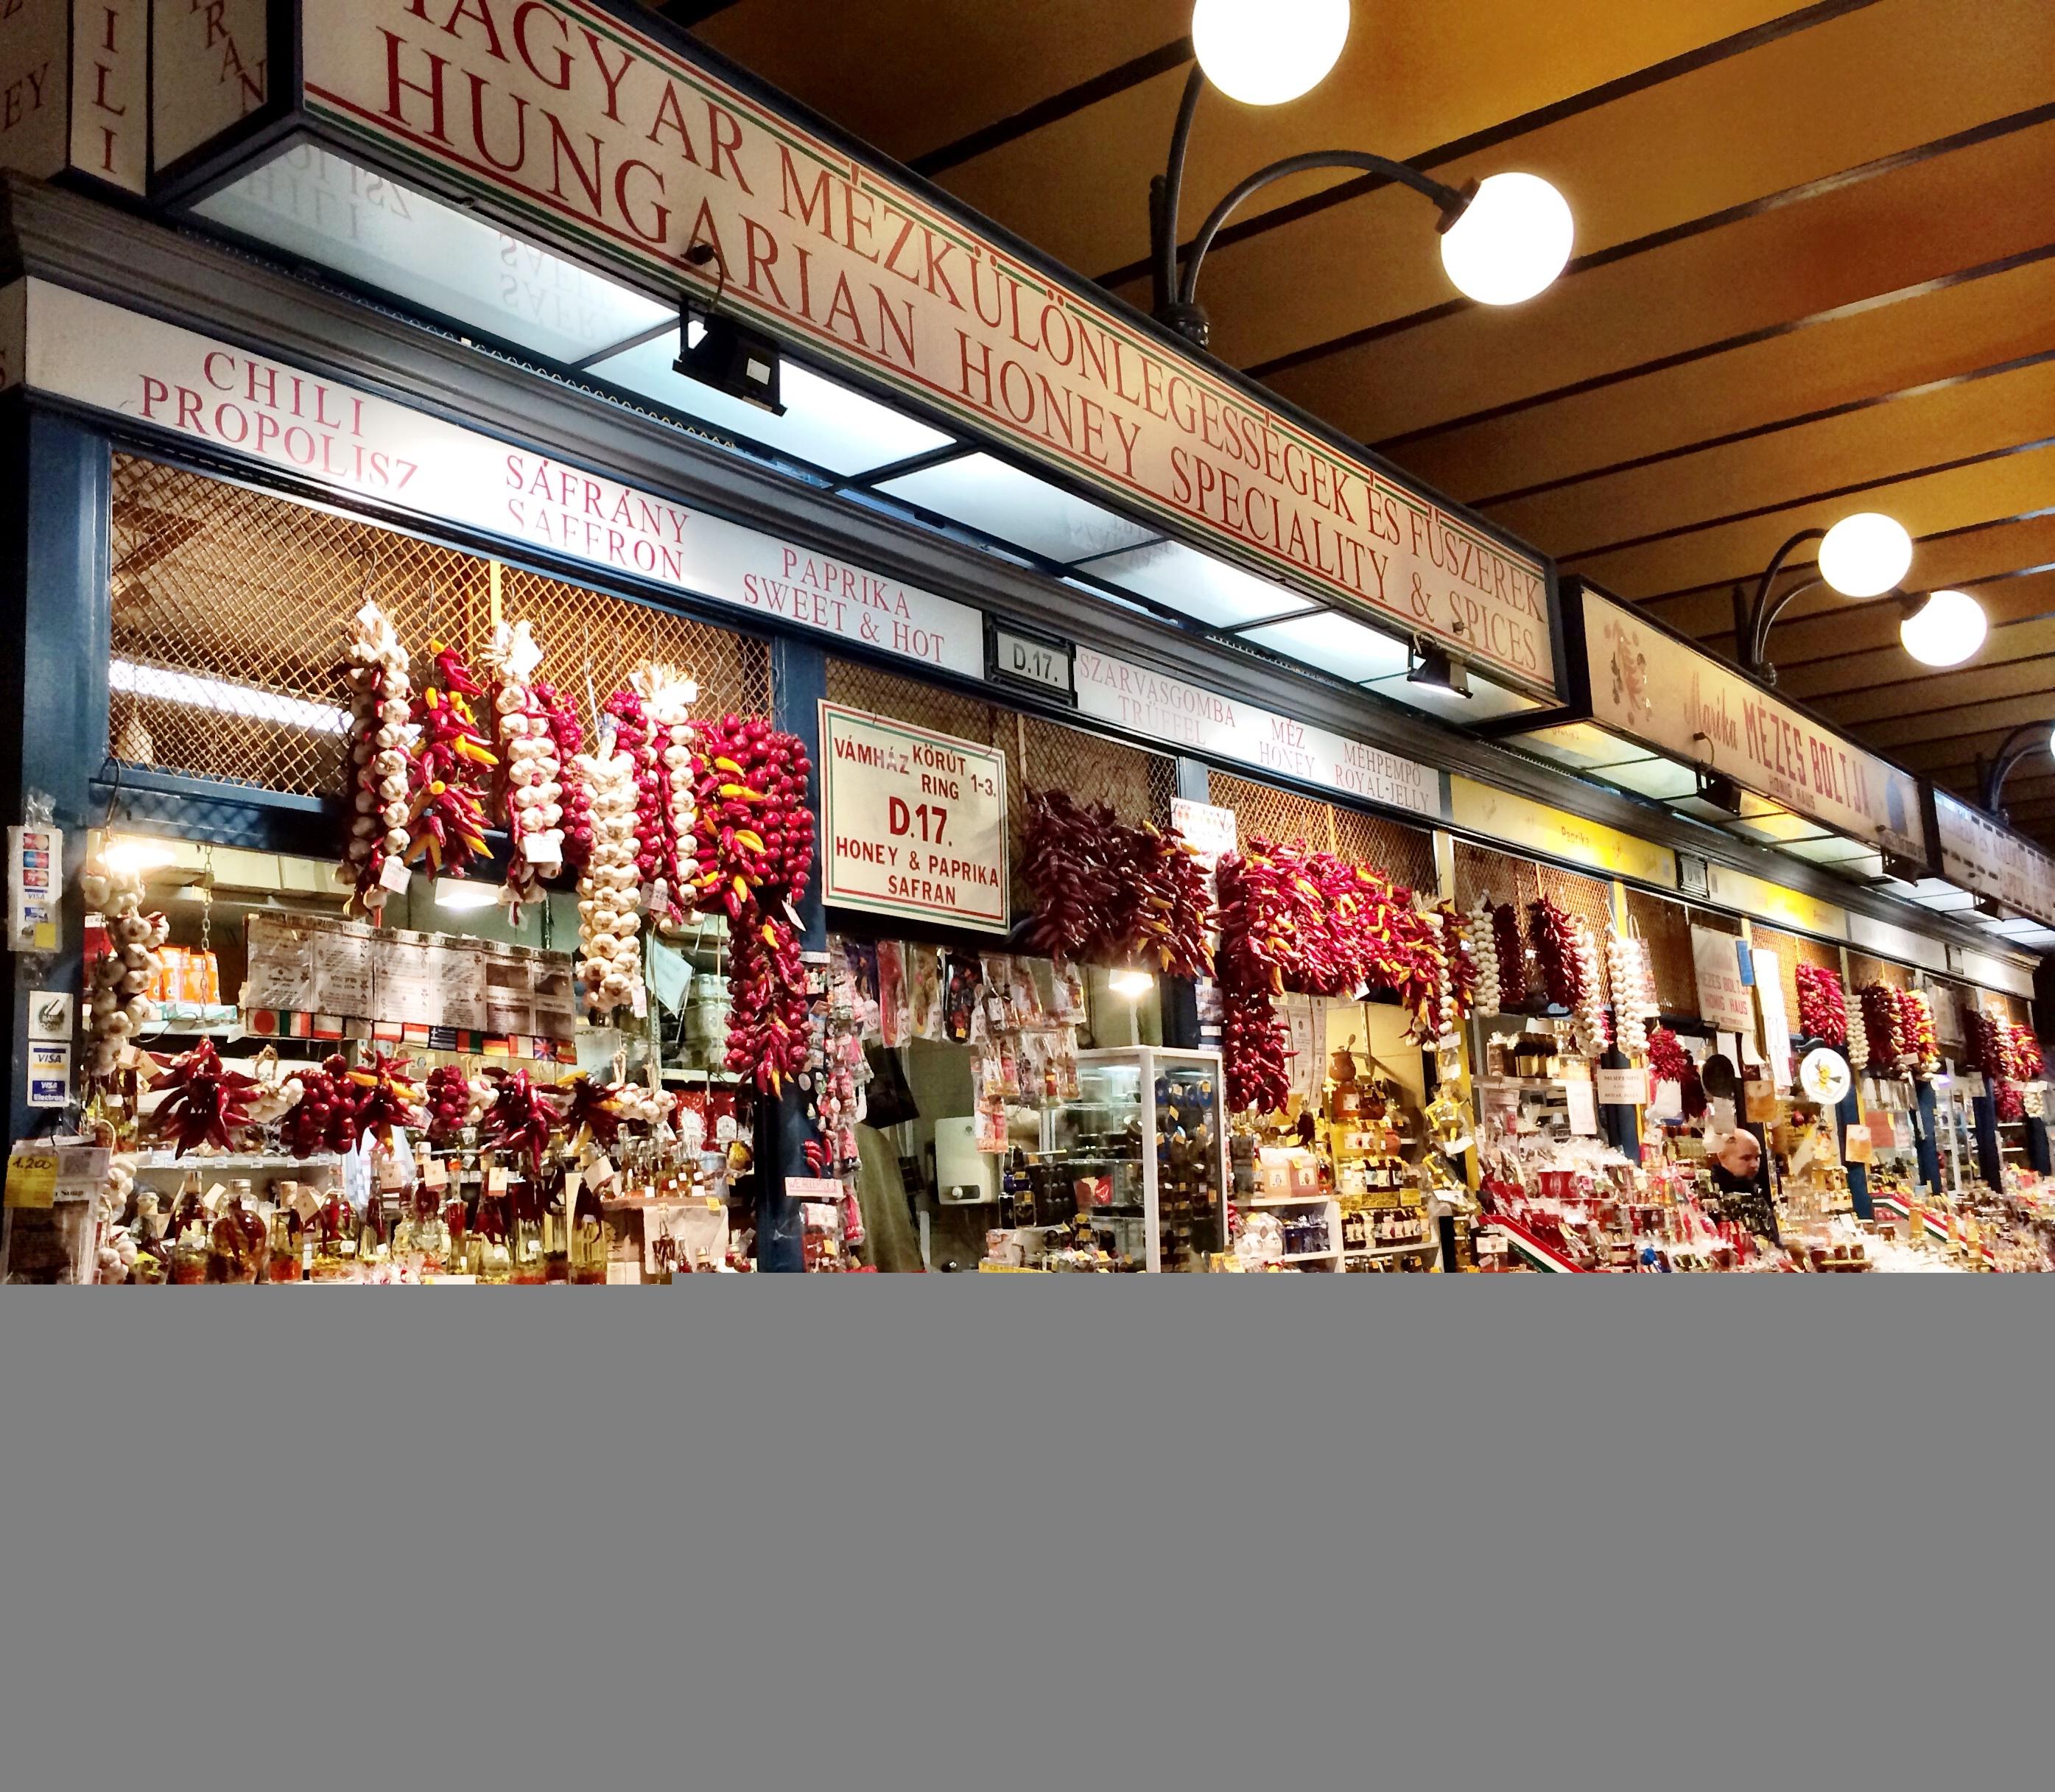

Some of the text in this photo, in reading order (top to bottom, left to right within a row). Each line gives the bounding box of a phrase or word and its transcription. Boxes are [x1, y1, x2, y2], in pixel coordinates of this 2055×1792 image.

[189, 0, 267, 114] RAN
[403, 0, 753, 195] AGYAR
[776, 142, 1357, 526] MÉZKÜLÖNLEGESSÉGEK
[1368, 470, 1401, 547] ÉS
[376, 27, 916, 369] HUNGARIAN
[954, 326, 1141, 479] HONEY
[1170, 446, 1388, 601] SPECIALITY
[1411, 572, 1436, 622] &
[1450, 590, 1537, 671] SPICES
[203, 351, 365, 438] CHILI
[506, 454, 689, 545] SÁFRÁNY
[507, 499, 684, 582] SAFFRON
[781, 547, 912, 619] PAPRIKA
[743, 574, 944, 663] SWEET & HOT
[1080, 653, 1236, 728] SZARVASGOMBA
[1260, 741, 1315, 779] HONEY
[1271, 717, 1305, 750] MÉZ
[1743, 694, 1807, 786] MÉZES
[834, 735, 996, 797] VÁMHÁZ KÖRÚT 1-3.
[921, 774, 959, 801] RING
[889, 795, 952, 847] D.17.
[1562, 826, 1589, 846] Paprika
[836, 836, 999, 888] HONEY & PAPRIKA
[888, 875, 956, 905] SAFRAN
[38, 1054, 61, 1063] VISA
[41, 1081, 57, 1089] VISA
[33, 1093, 64, 1102] Electron
